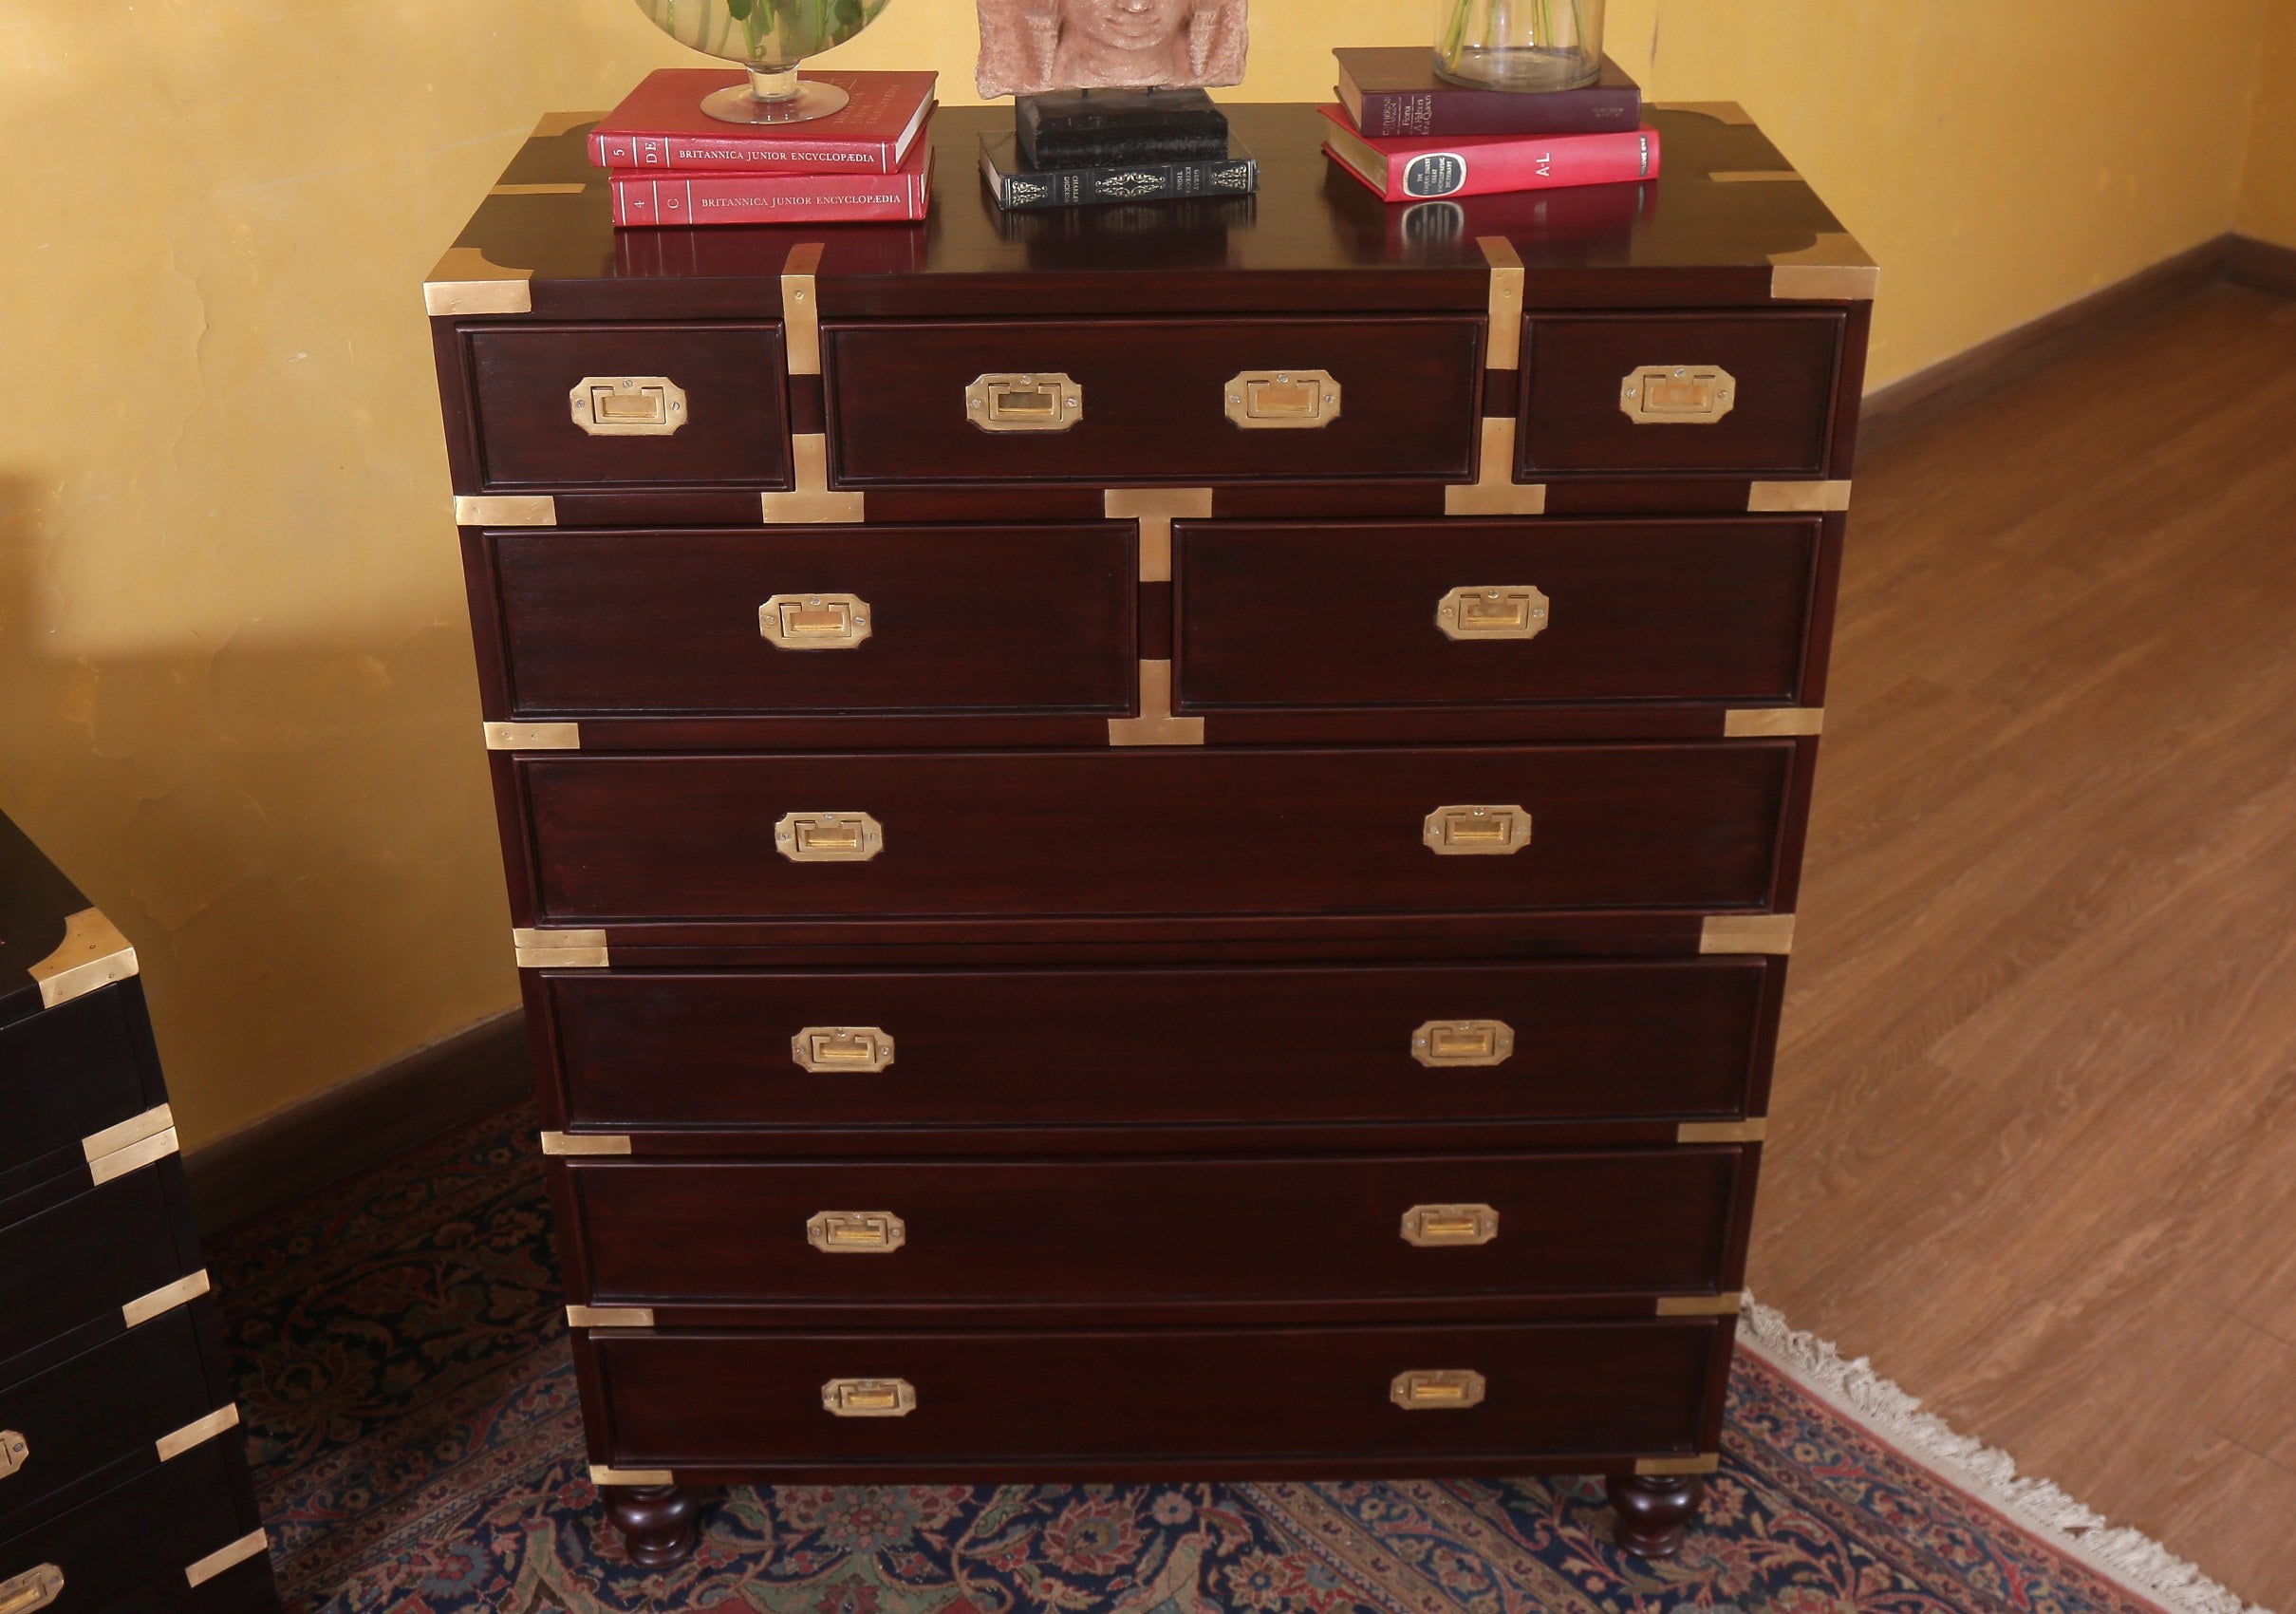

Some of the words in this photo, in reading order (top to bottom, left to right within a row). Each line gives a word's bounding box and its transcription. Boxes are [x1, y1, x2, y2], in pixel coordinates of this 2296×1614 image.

[679, 150, 743, 160] BRITANNICA
[747, 150, 787, 161] JUNIOR
[1536, 153, 1549, 177] A-L
[634, 199, 645, 208] 4
[667, 198, 679, 209] C
[701, 197, 768, 207] BRITANNICA
[772, 197, 812, 207] JUNIOR
